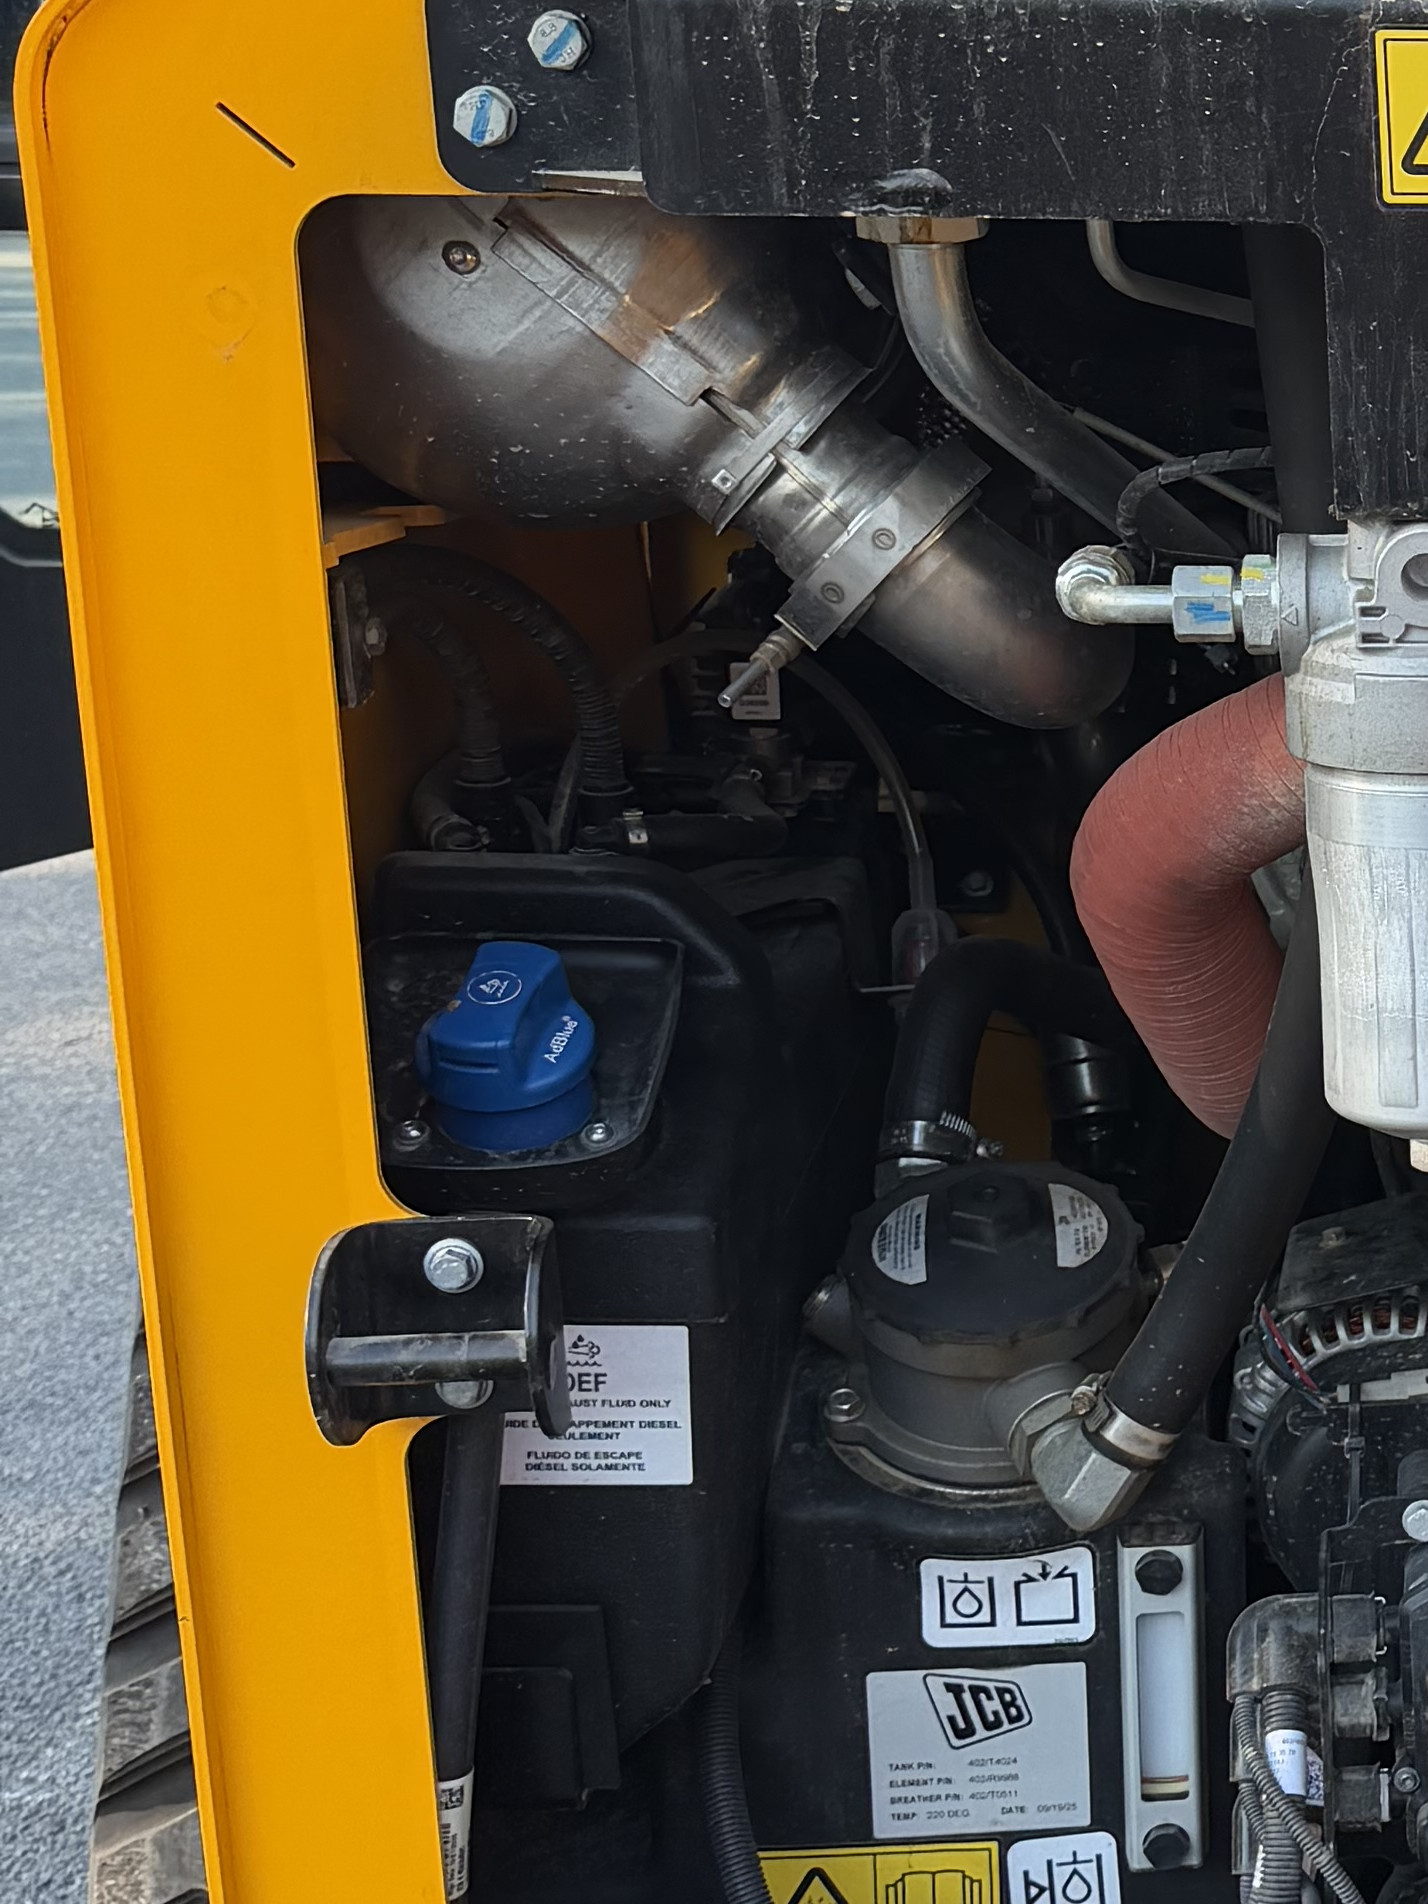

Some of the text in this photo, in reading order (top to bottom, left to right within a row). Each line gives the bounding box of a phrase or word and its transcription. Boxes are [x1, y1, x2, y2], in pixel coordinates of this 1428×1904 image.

[601, 1399, 636, 1408] FLUID
[639, 1399, 671, 1409] ONLY
[638, 1420, 682, 1429] DIESEL
[527, 1451, 643, 1460] FLUIDO DE ESCAPE
[571, 1462, 646, 1471] SOLAMENTE
[943, 1682, 1025, 1740] JCB
[888, 1762, 915, 1772] TANK
[889, 1777, 934, 1789] ELEMENT
[890, 1793, 943, 1805] BREATHER
